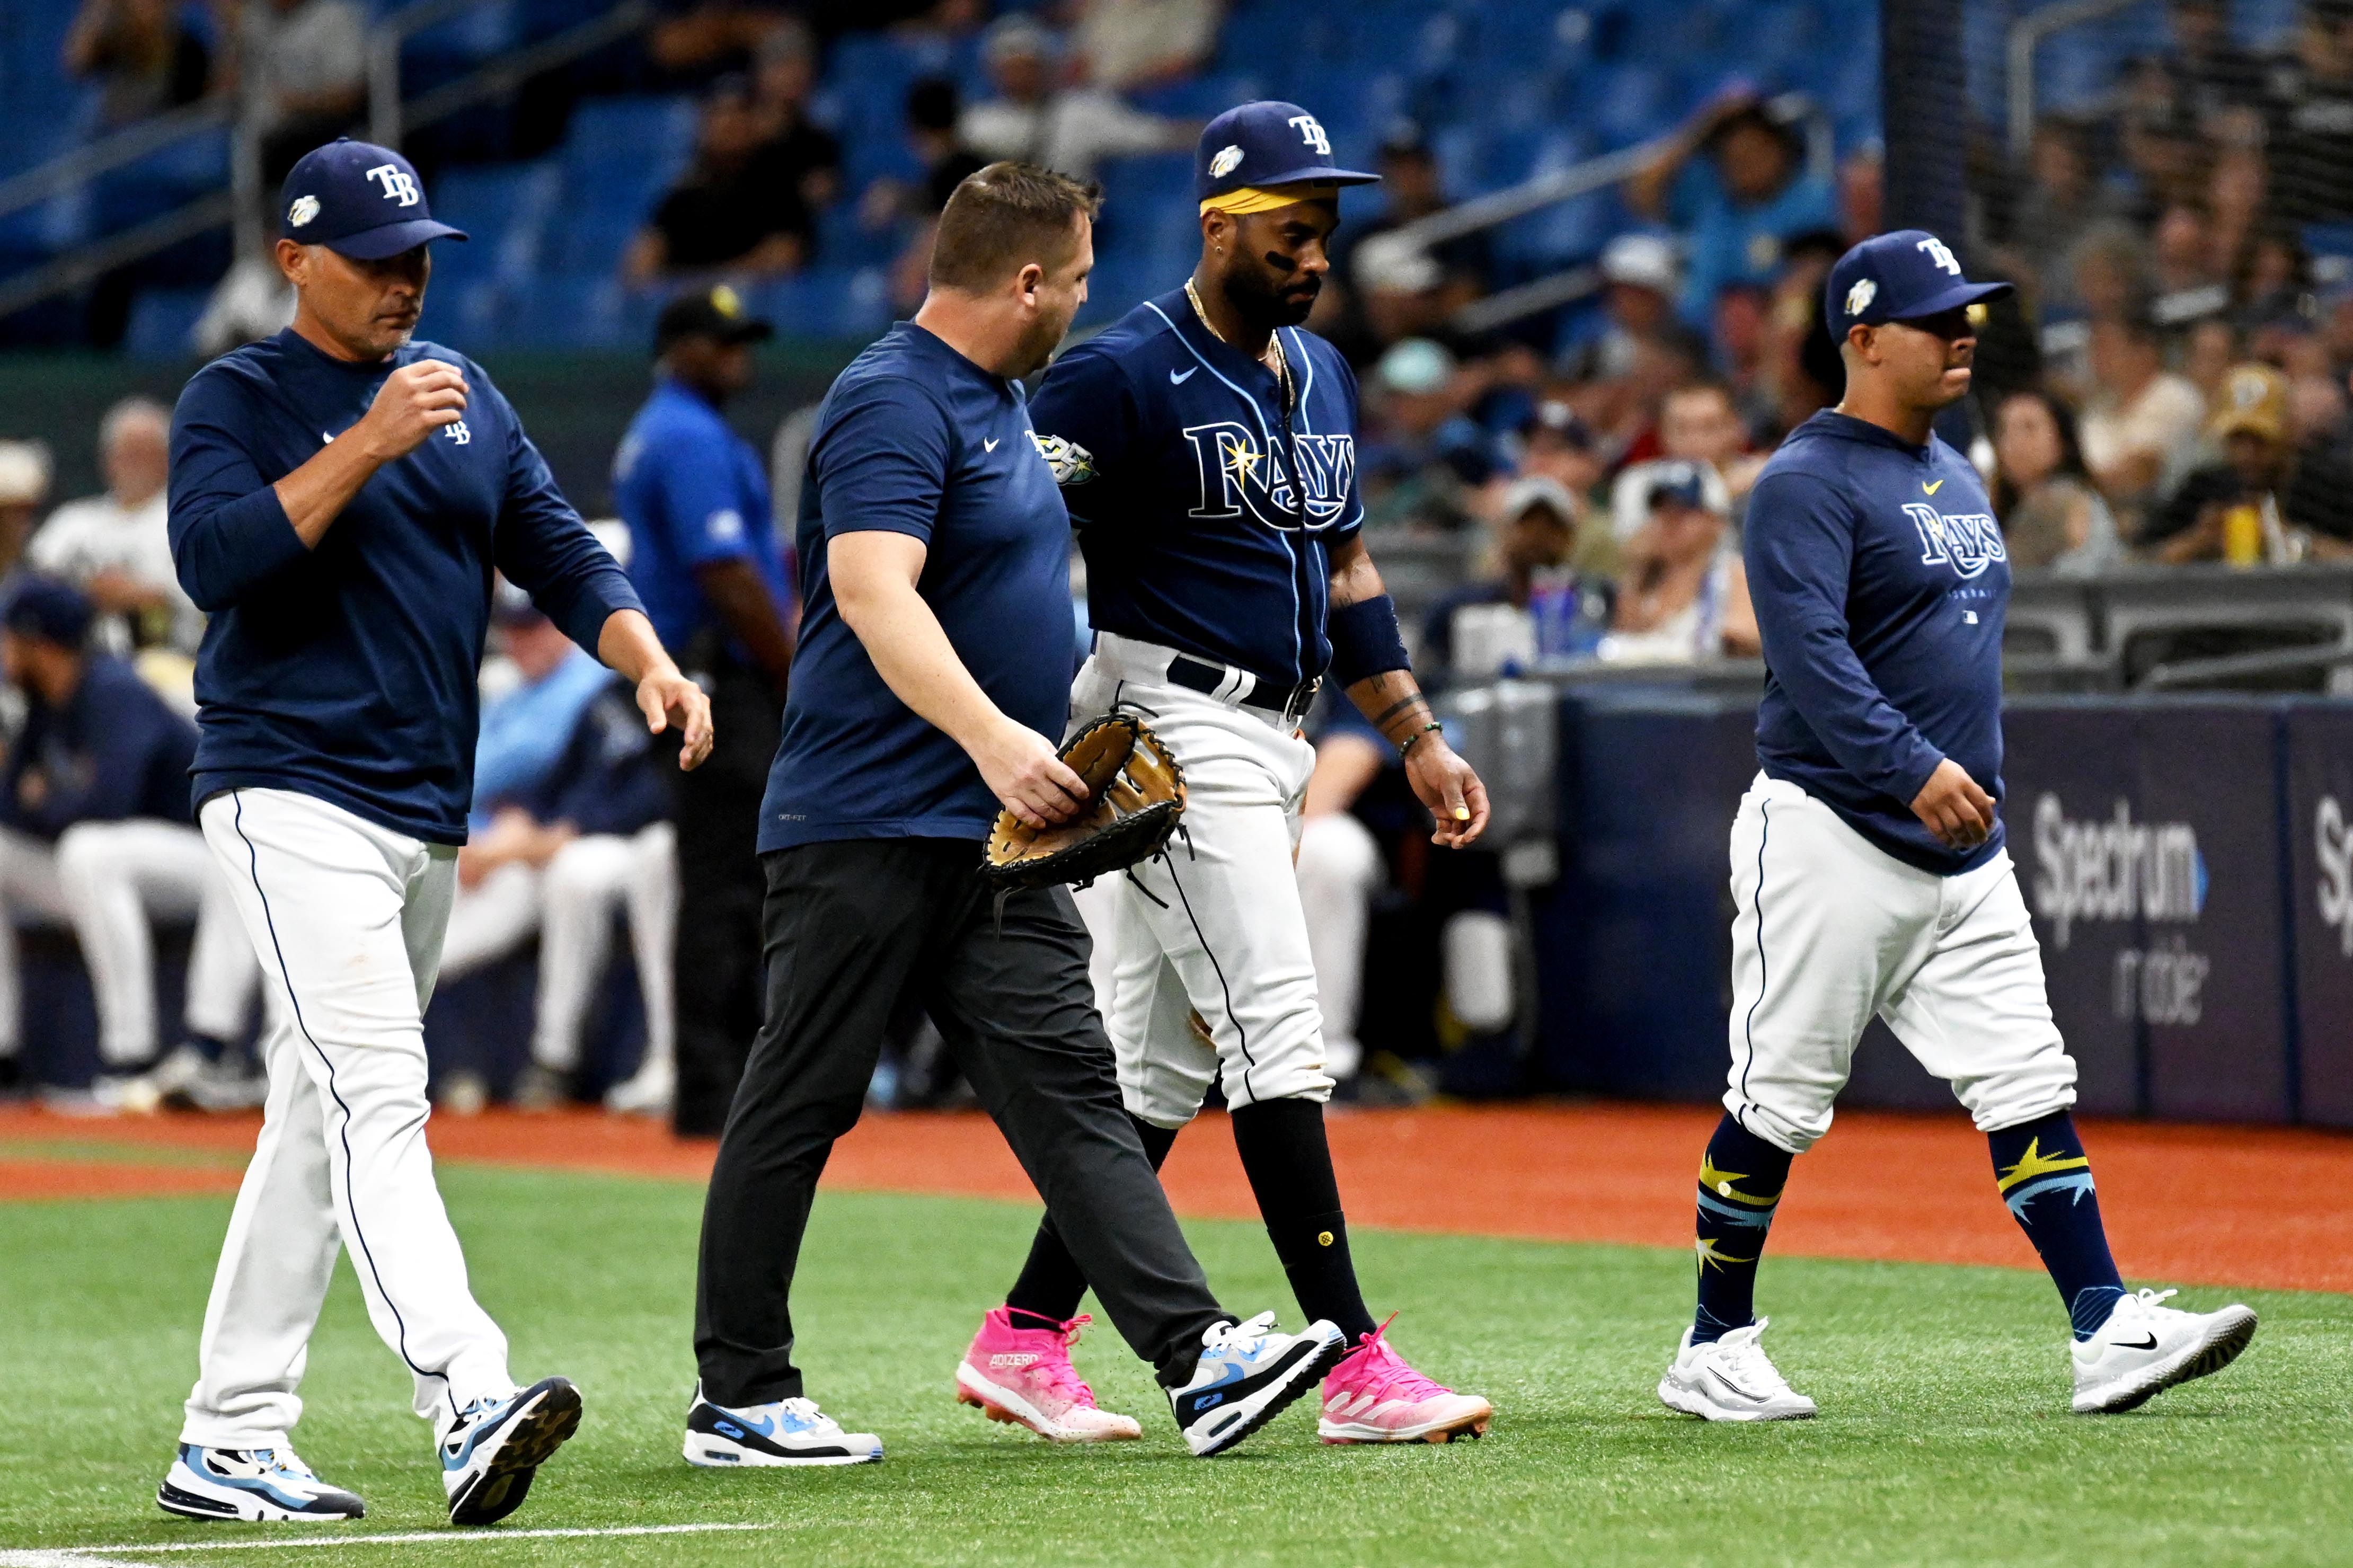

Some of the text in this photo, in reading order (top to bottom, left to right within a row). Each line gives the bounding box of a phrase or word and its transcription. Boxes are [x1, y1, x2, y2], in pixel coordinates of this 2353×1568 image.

[1288, 116, 1331, 155] TB
[366, 164, 419, 207] TB
[1916, 238, 1961, 276] TB
[2033, 792, 2199, 950] Spectrum
[989, 1354, 1038, 1366] ADIZERO
